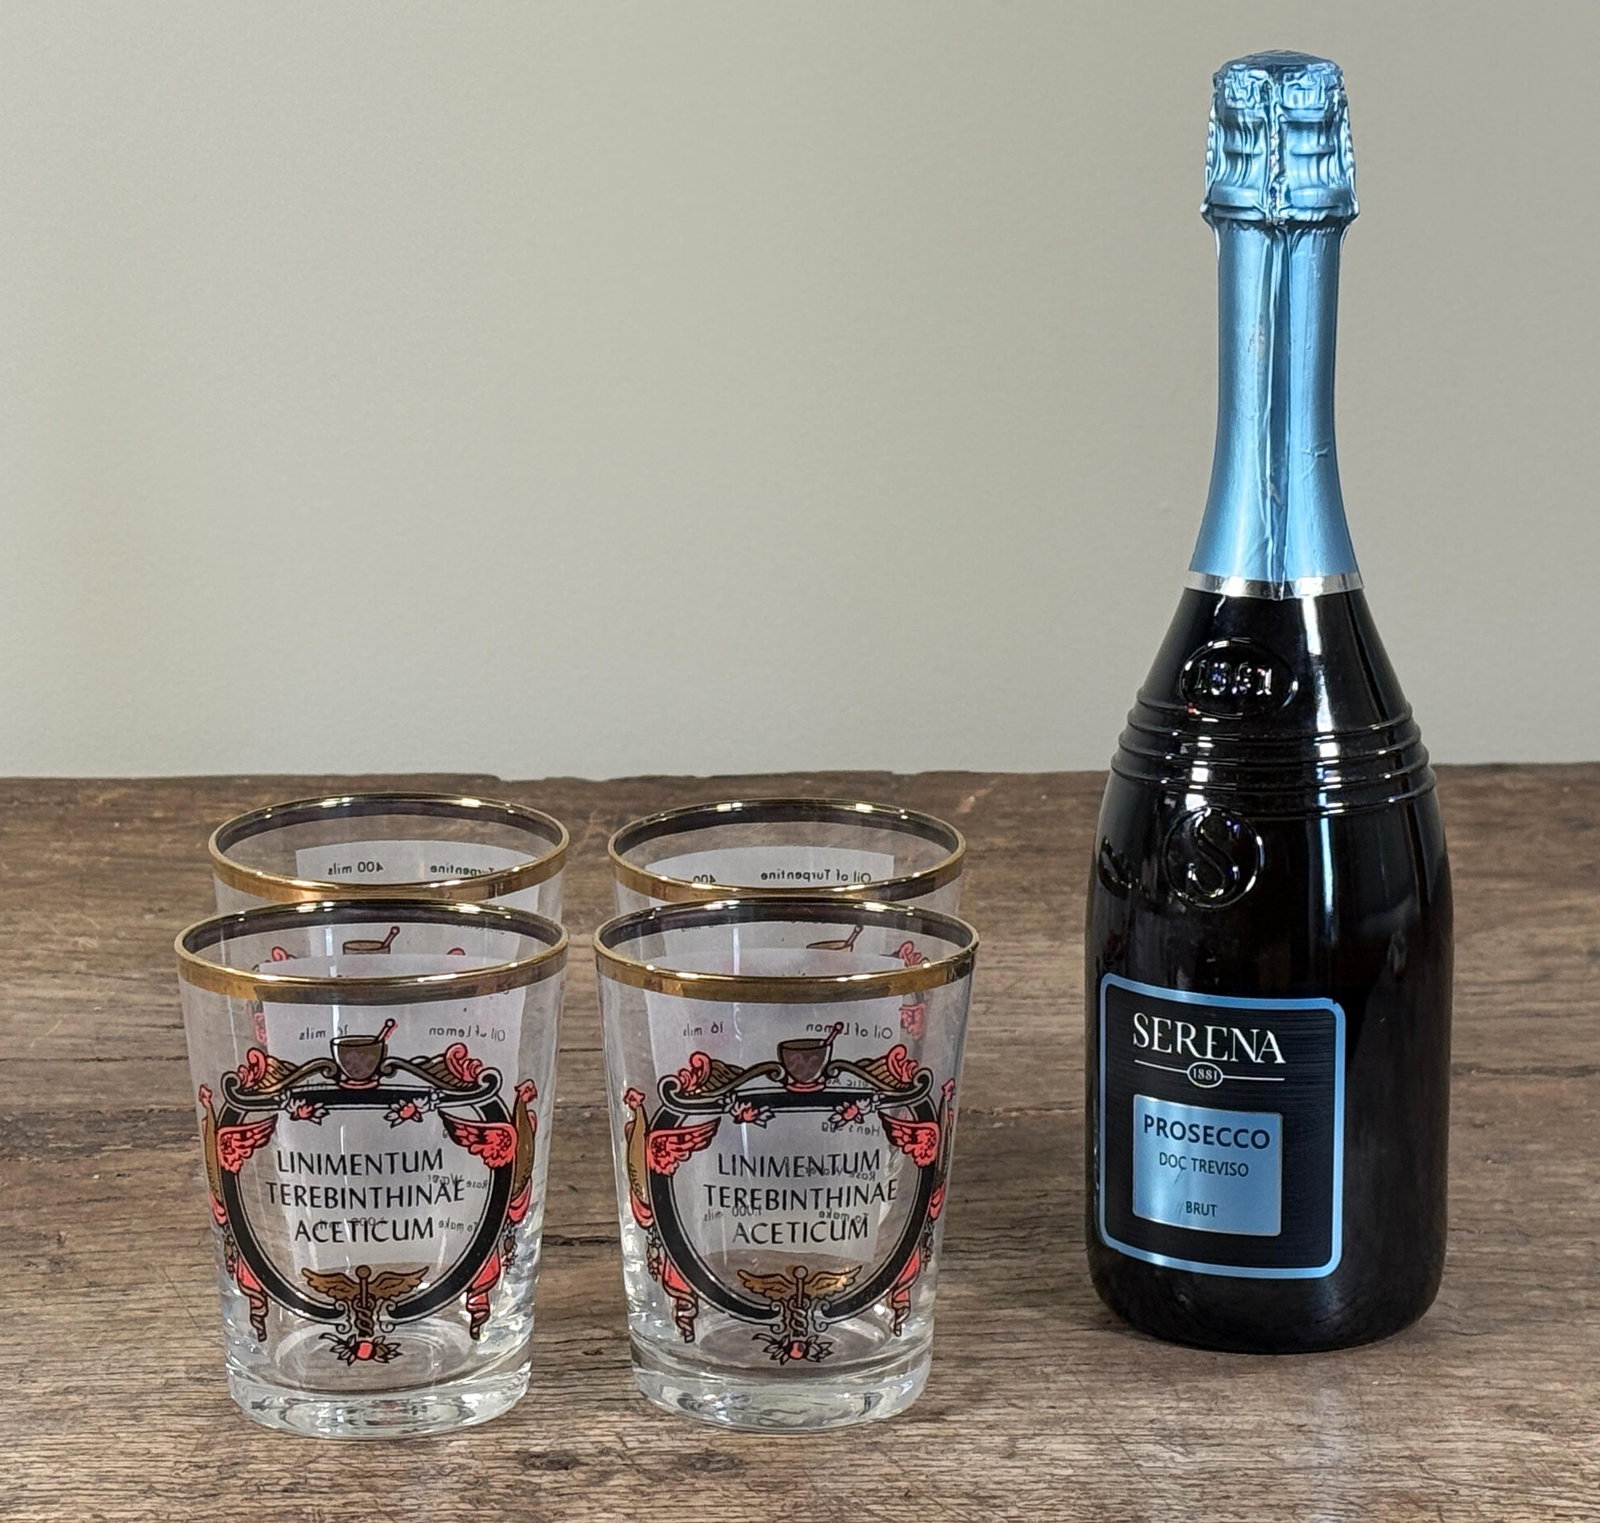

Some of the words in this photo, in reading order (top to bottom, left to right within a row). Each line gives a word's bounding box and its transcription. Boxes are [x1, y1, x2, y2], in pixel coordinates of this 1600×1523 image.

[1133, 1012, 1286, 1064] SERENA
[1193, 1067, 1218, 1081] 1881
[1143, 1113, 1271, 1150] PROSECCO
[277, 1148, 444, 1176] LINIMENTUM
[717, 1149, 881, 1178] LINIMENTUM
[1159, 1152, 1187, 1171] DOC
[1191, 1157, 1250, 1177] TREVISO
[265, 1178, 466, 1210] TEREBINTHINAE
[703, 1179, 898, 1211] TEREBINTHINAE
[1185, 1201, 1218, 1217] BRUT
[294, 1217, 435, 1243] ACETICUM
[732, 1220, 869, 1245] ACETICUM
